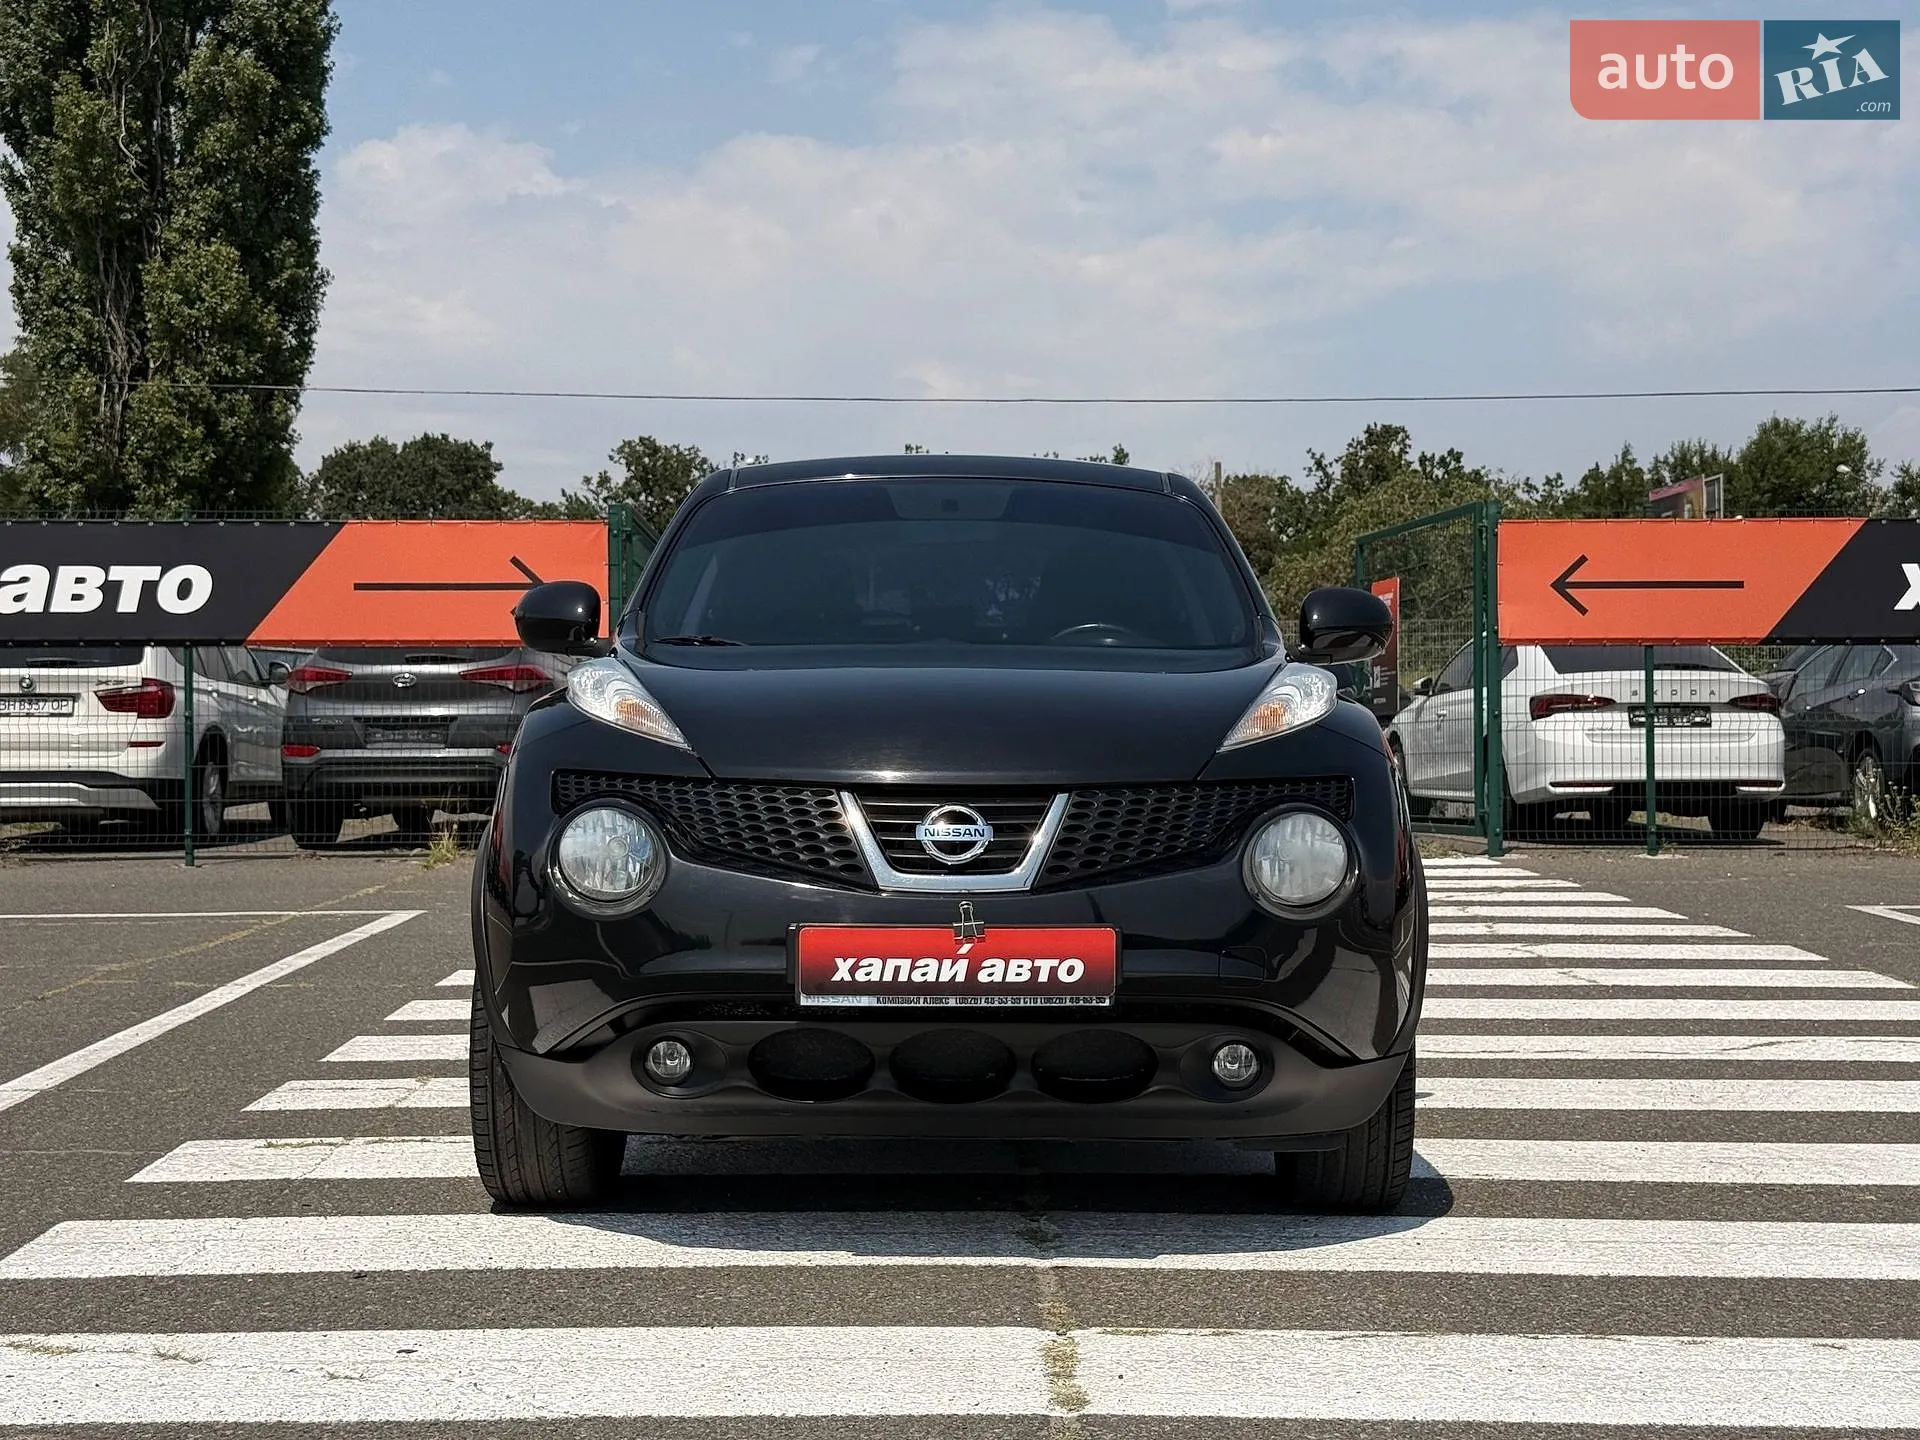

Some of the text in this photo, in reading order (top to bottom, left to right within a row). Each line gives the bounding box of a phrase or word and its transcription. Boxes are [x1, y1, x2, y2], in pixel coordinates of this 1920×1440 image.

[0, 563, 214, 615] авто
[923, 826, 986, 838] NISSAN
[831, 943, 1085, 983] хапай авто
